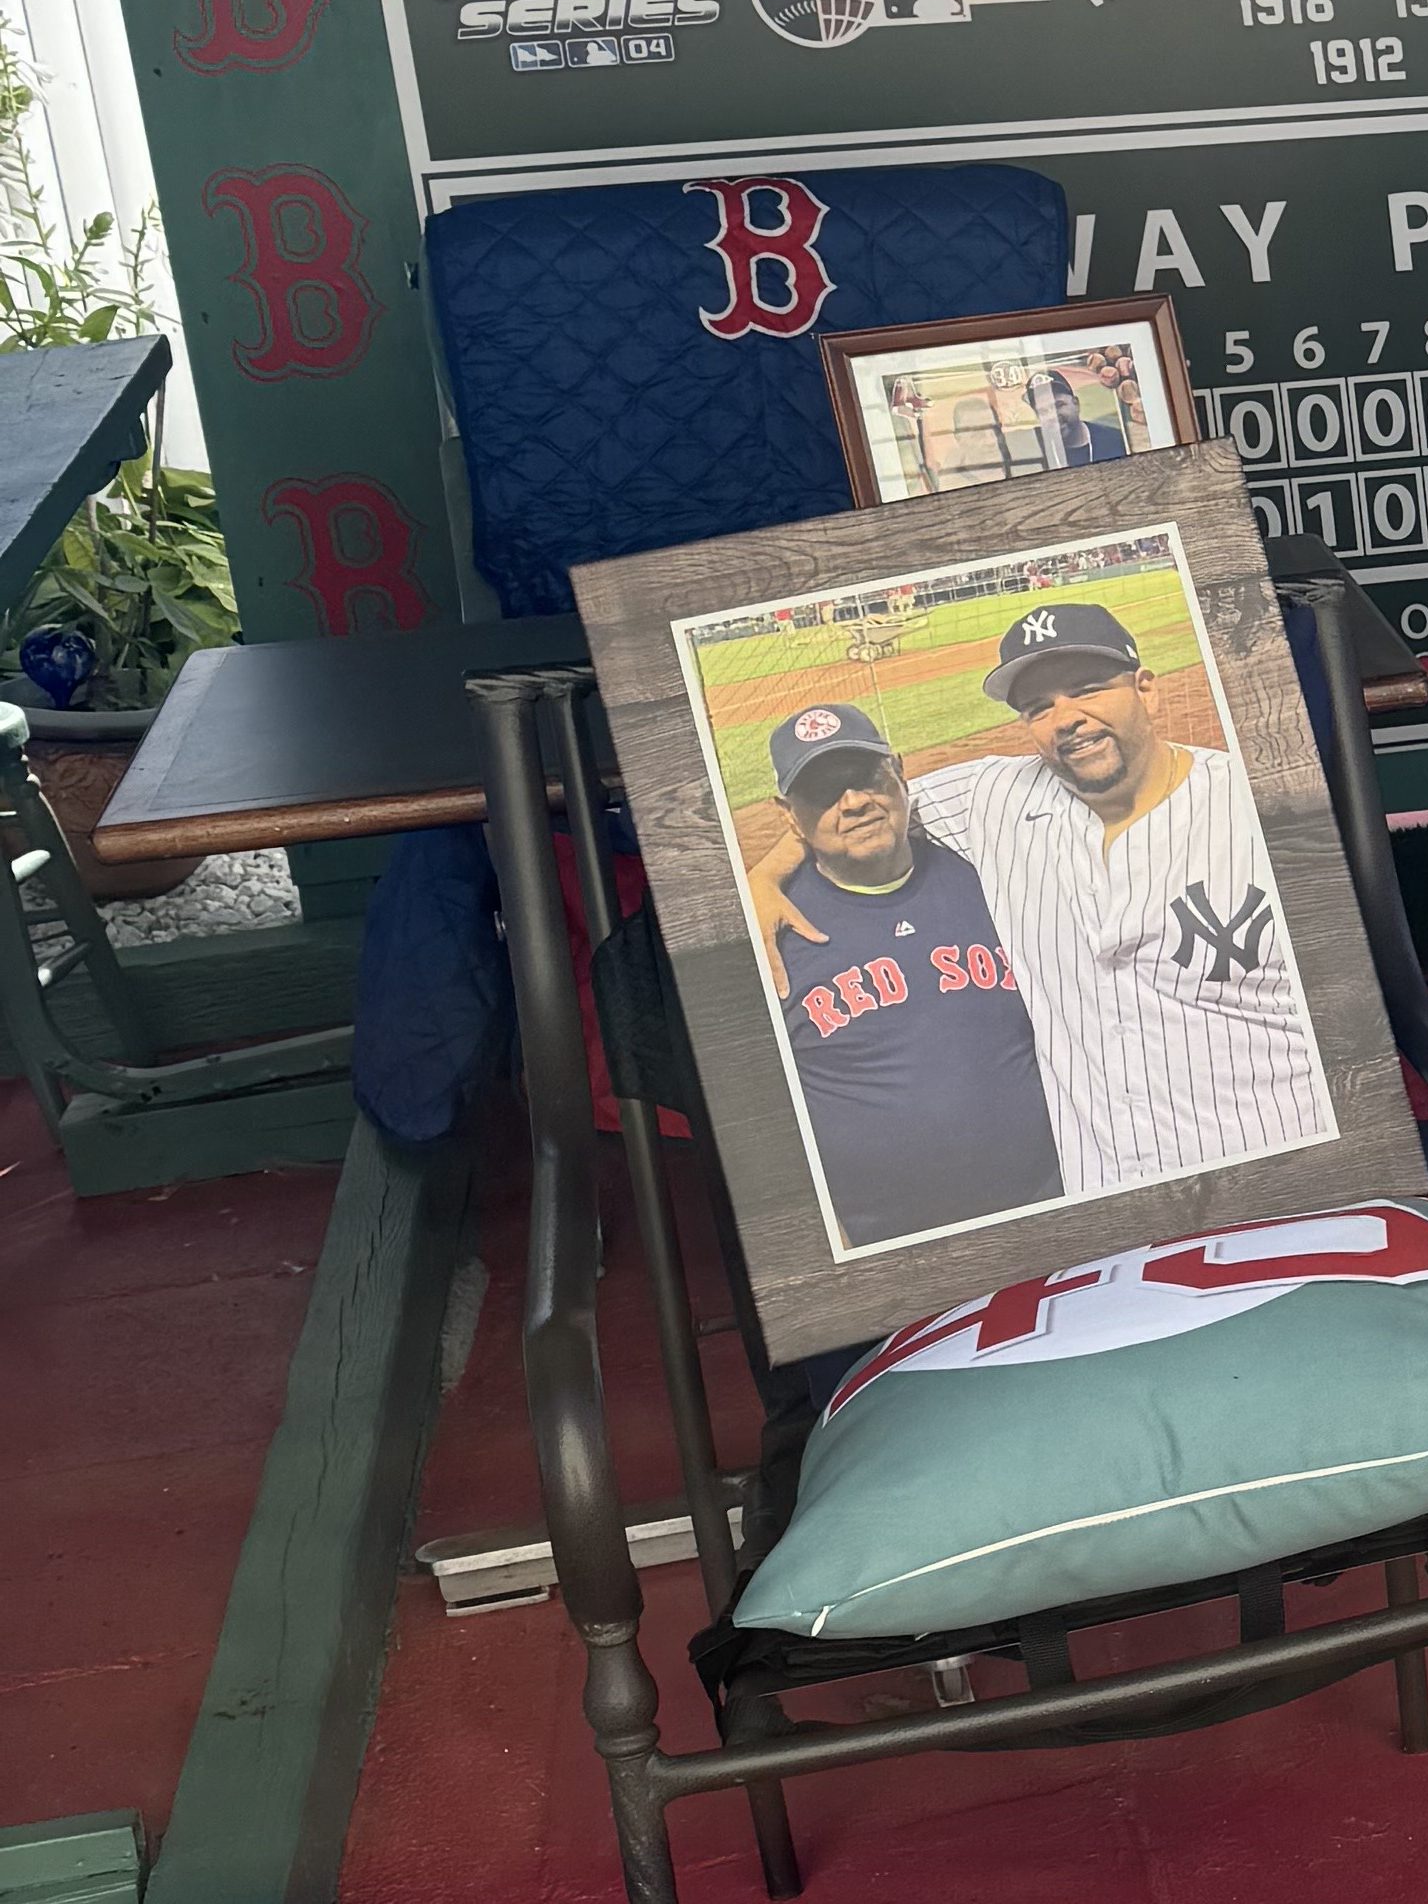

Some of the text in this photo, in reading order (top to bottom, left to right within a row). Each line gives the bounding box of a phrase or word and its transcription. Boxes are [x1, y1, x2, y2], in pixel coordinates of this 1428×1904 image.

[627, 36, 669, 60] 04
[1310, 36, 1407, 86] 1912
[201, 161, 387, 384] B
[682, 176, 838, 340] B
[1224, 330, 1255, 374] 5
[1293, 326, 1326, 370] 6
[1360, 321, 1390, 365] 7
[1229, 400, 1274, 460] 0
[1296, 393, 1341, 453] 0
[1362, 388, 1406, 447] 0
[1305, 490, 1337, 547] 1
[1373, 483, 1417, 541] 0
[801, 956, 909, 1039] RED
